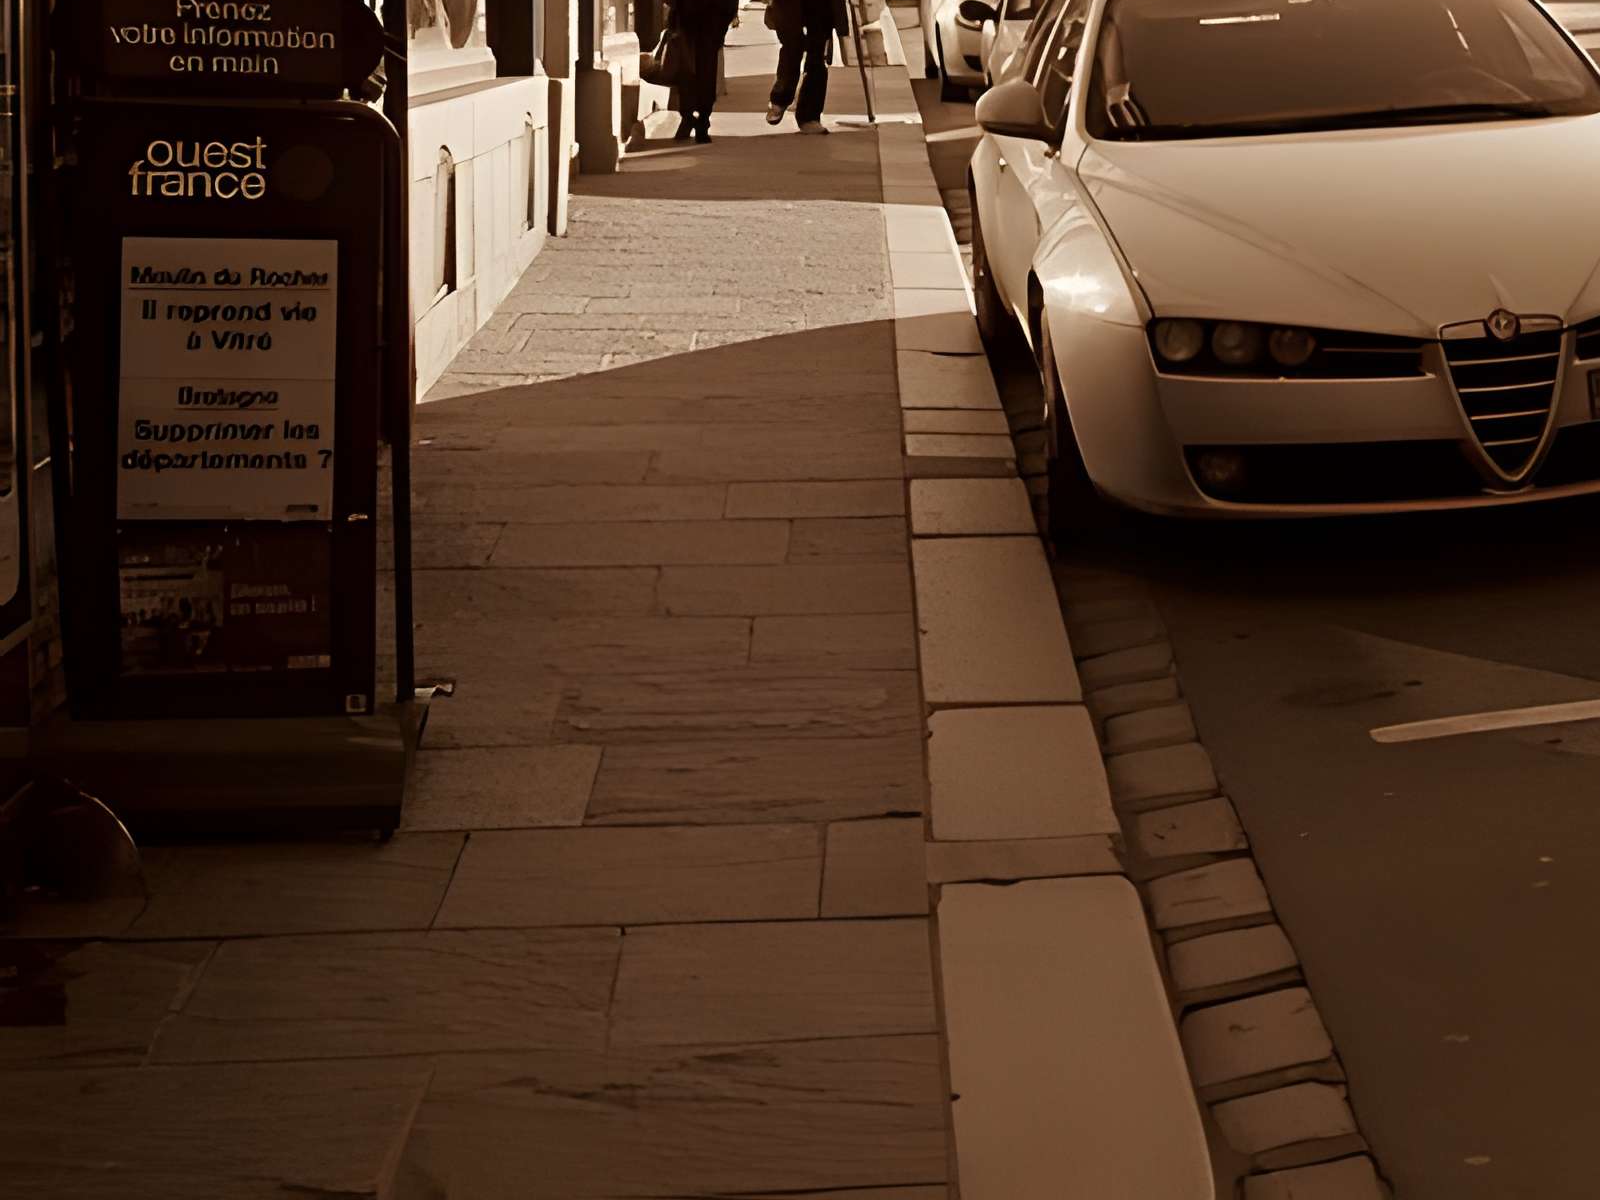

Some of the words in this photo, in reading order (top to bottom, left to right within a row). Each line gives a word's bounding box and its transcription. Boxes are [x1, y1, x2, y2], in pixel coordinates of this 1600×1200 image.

[169, 55, 204, 72] en
[147, 136, 267, 169] ouest
[128, 160, 266, 199] france
